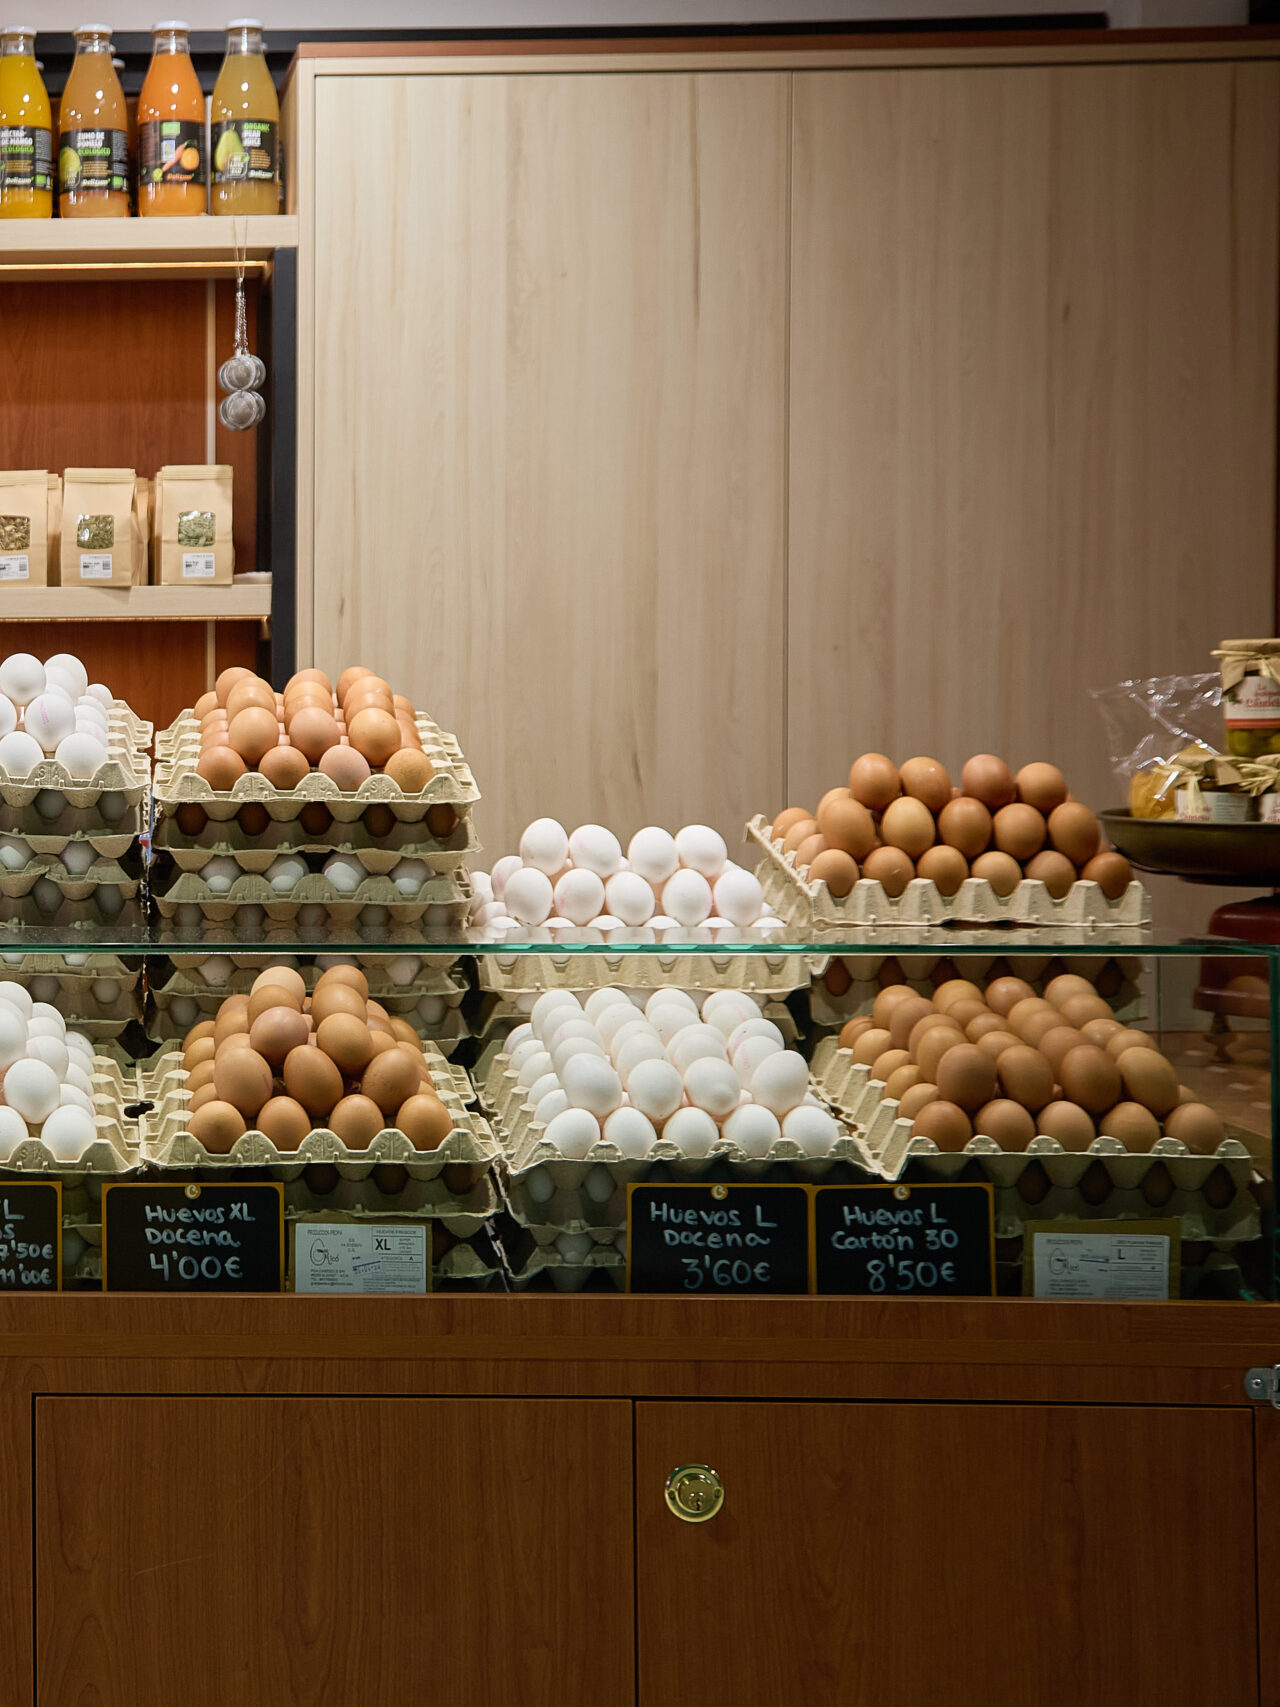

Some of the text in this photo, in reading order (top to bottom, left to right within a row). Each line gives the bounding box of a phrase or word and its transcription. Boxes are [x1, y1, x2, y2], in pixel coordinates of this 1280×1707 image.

[77, 132, 95, 140] ZUMO
[242, 130, 261, 138] PEAR
[1, 137, 33, 145] DE MANGO
[77, 139, 102, 148] POMELO
[242, 137, 262, 147] JUICE
[145, 1202, 256, 1225] Huevos XL
[650, 1201, 778, 1228] Huevos L
[843, 1202, 948, 1228] Huevos L
[144, 1227, 242, 1247] Docena
[663, 1229, 771, 1248] Docena
[830, 1228, 959, 1251] Cartón 30
[375, 1238, 392, 1251] XL
[1117, 1247, 1126, 1260] L
